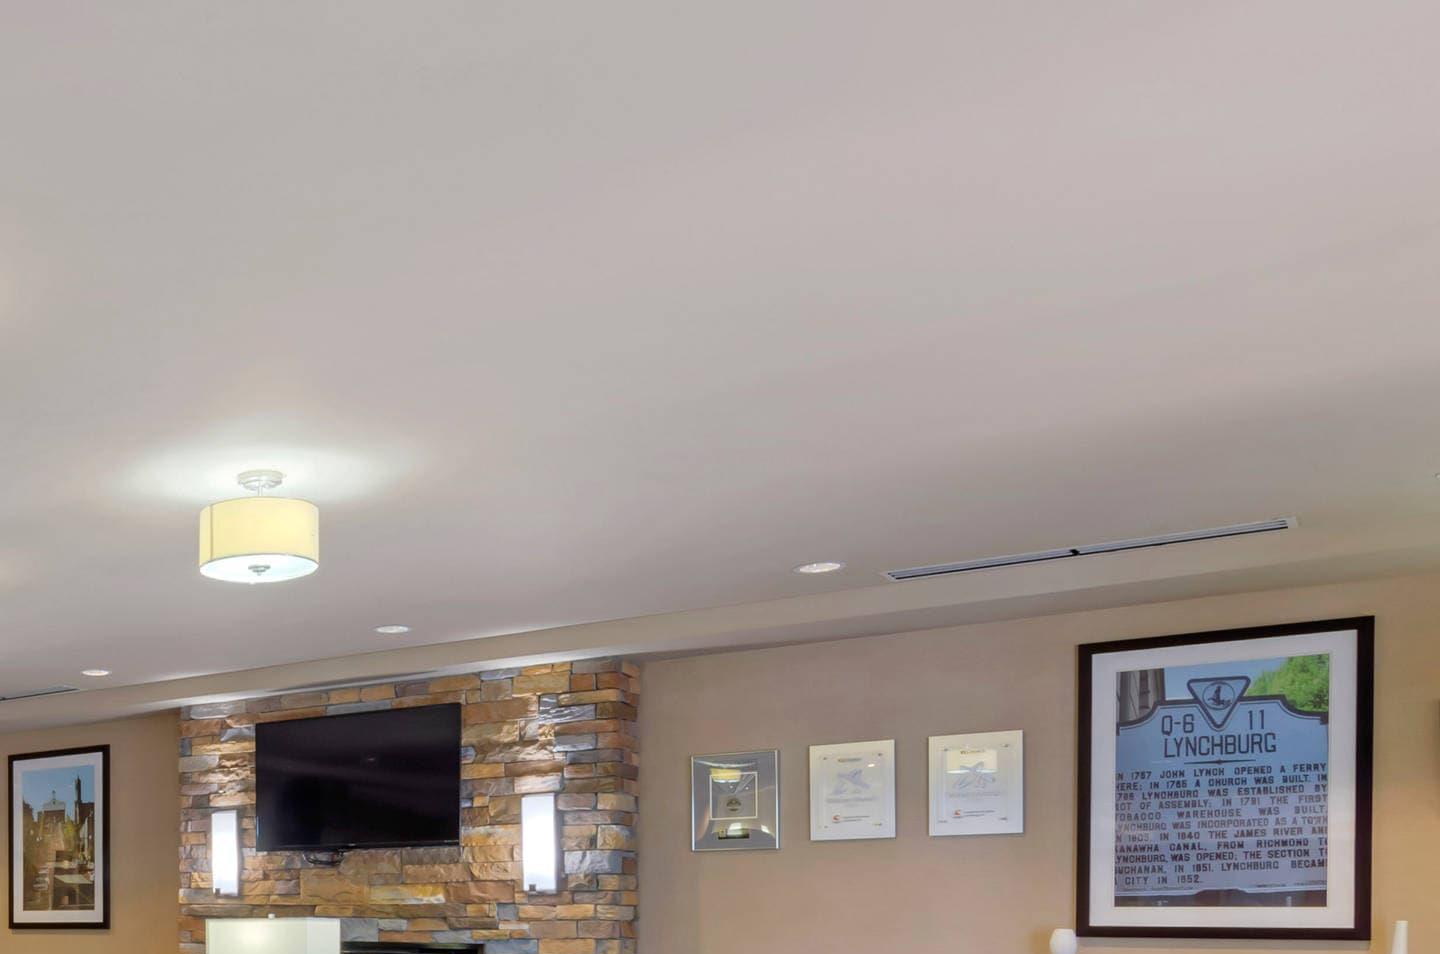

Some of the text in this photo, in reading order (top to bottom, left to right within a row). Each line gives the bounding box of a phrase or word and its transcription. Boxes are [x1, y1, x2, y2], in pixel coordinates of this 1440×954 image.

[1161, 714, 1194, 736] Q-6
[1164, 732, 1277, 758] LYNCHBURG
[1160, 770, 1185, 779] JOHN
[1193, 768, 1225, 777] LYNCH
[1234, 765, 1272, 775] OPENED
[1280, 765, 1286, 773] A
[1293, 763, 1327, 773] FERRY
[1208, 777, 1247, 787] CHURCH
[1254, 776, 1274, 785] WAS
[1142, 790, 1199, 801] LYNCHBURG
[1208, 788, 1229, 798] WAS
[1237, 785, 1305, 796] ESTABLISHED
[1314, 784, 1327, 792] BY
[1140, 801, 1152, 810] OF
[1222, 798, 1232, 806] IN
[1270, 796, 1289, 805] THE
[1298, 794, 1328, 803] FIRST
[1177, 808, 1242, 818] WAREHOUSE
[1258, 806, 1280, 816] WAS
[1116, 822, 1167, 832] YNCHBURG
[1171, 821, 1191, 830] WAS
[1197, 818, 1269, 829] INCORPORATED
[1275, 817, 1287, 826] AS
[1291, 816, 1298, 825] A
[1159, 832, 1169, 840] IN
[1208, 830, 1227, 839] THE
[1234, 828, 1267, 838] JAMES
[1273, 827, 1303, 836] RIVER
[1217, 841, 1244, 850] FROM
[1256, 838, 1309, 848] RICHMOND
[1171, 853, 1191, 862] WAS
[1243, 850, 1262, 860] THE
[1267, 849, 1310, 859] SECTION
[1174, 864, 1185, 873] IN
[1221, 861, 1279, 872] LYNCHBURG
[1124, 876, 1149, 885] CITY
[1158, 876, 1168, 885] IN
